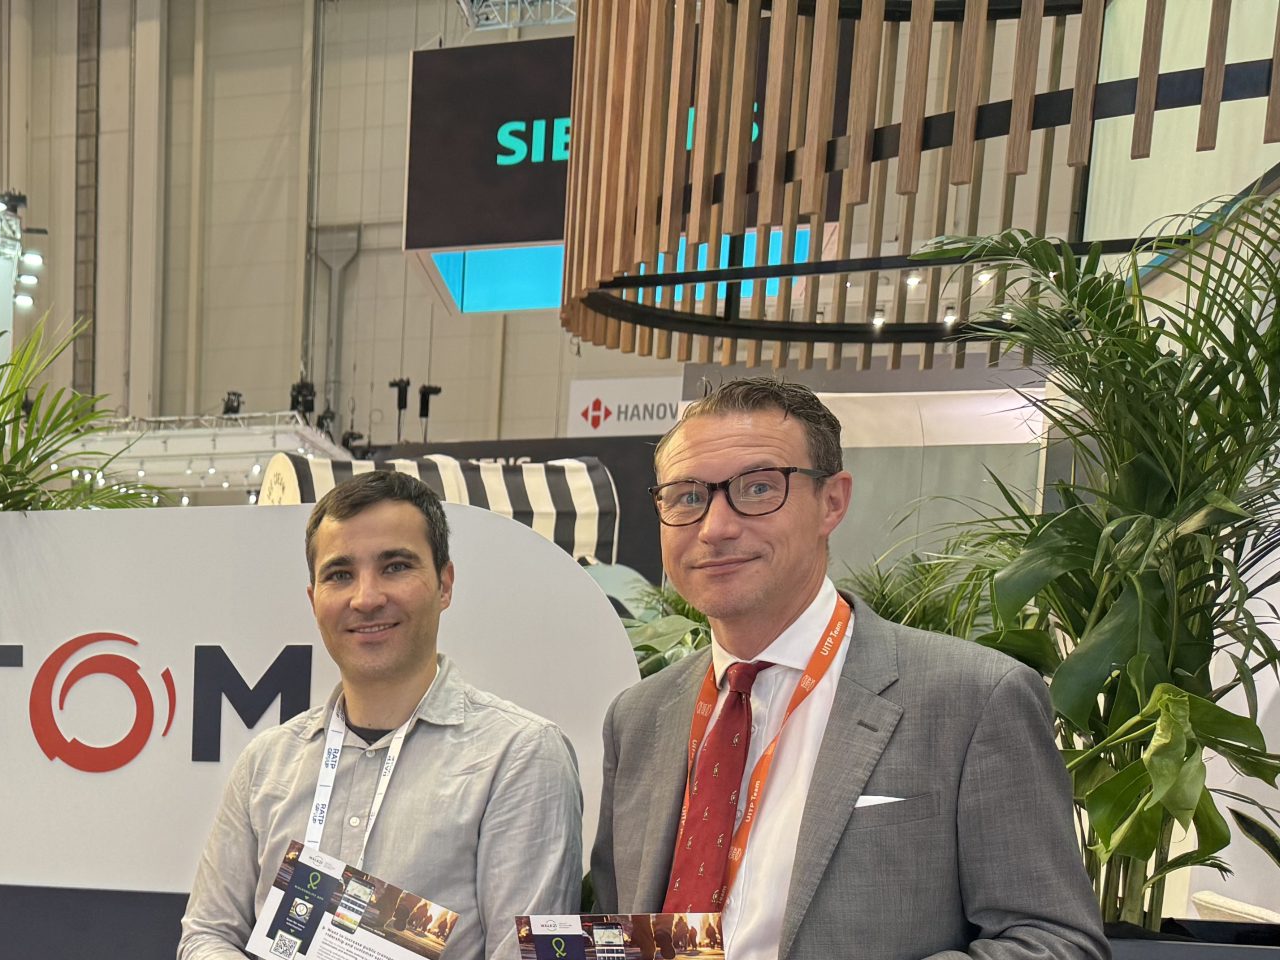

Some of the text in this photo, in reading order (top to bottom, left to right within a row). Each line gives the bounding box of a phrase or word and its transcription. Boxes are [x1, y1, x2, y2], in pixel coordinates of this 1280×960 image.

[617, 402, 678, 422] HANOV
[820, 620, 843, 656] UITP Team
[331, 748, 339, 769] RATP
[746, 780, 760, 823] UITP Team
[318, 804, 327, 825] RATP
